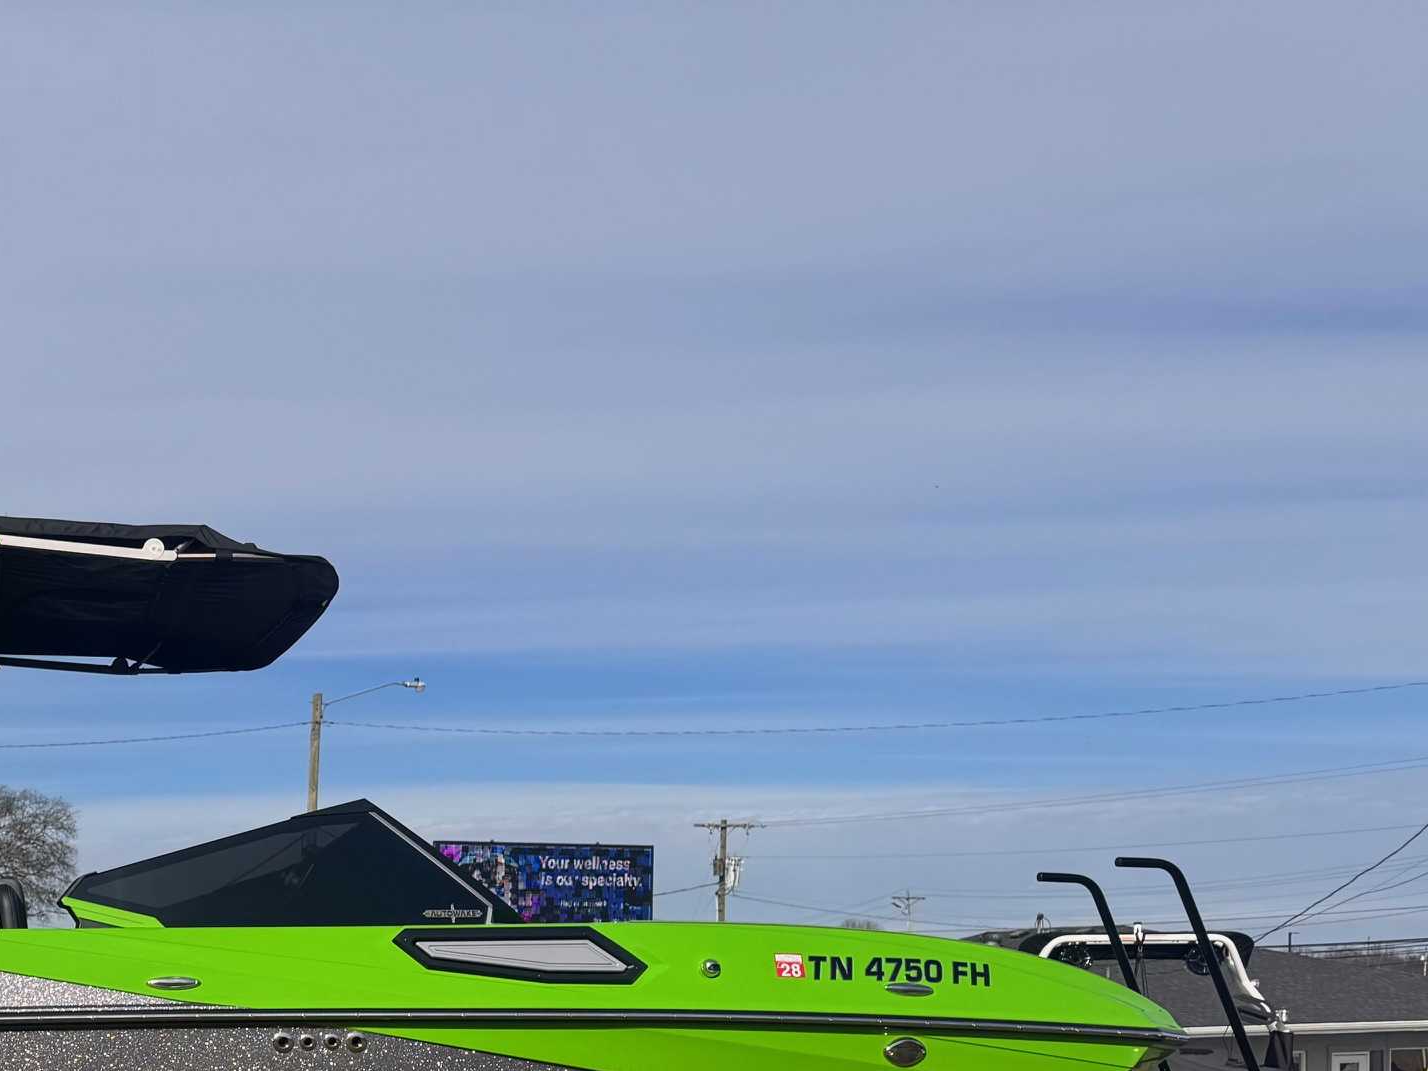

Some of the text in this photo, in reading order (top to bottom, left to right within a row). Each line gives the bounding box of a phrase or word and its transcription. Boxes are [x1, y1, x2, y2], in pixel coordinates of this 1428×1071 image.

[539, 856, 631, 870] Your wellness
[540, 872, 553, 886] is
[581, 873, 643, 890] specialty.
[780, 963, 802, 977] 28
[808, 956, 991, 987] TN 4750 FH
